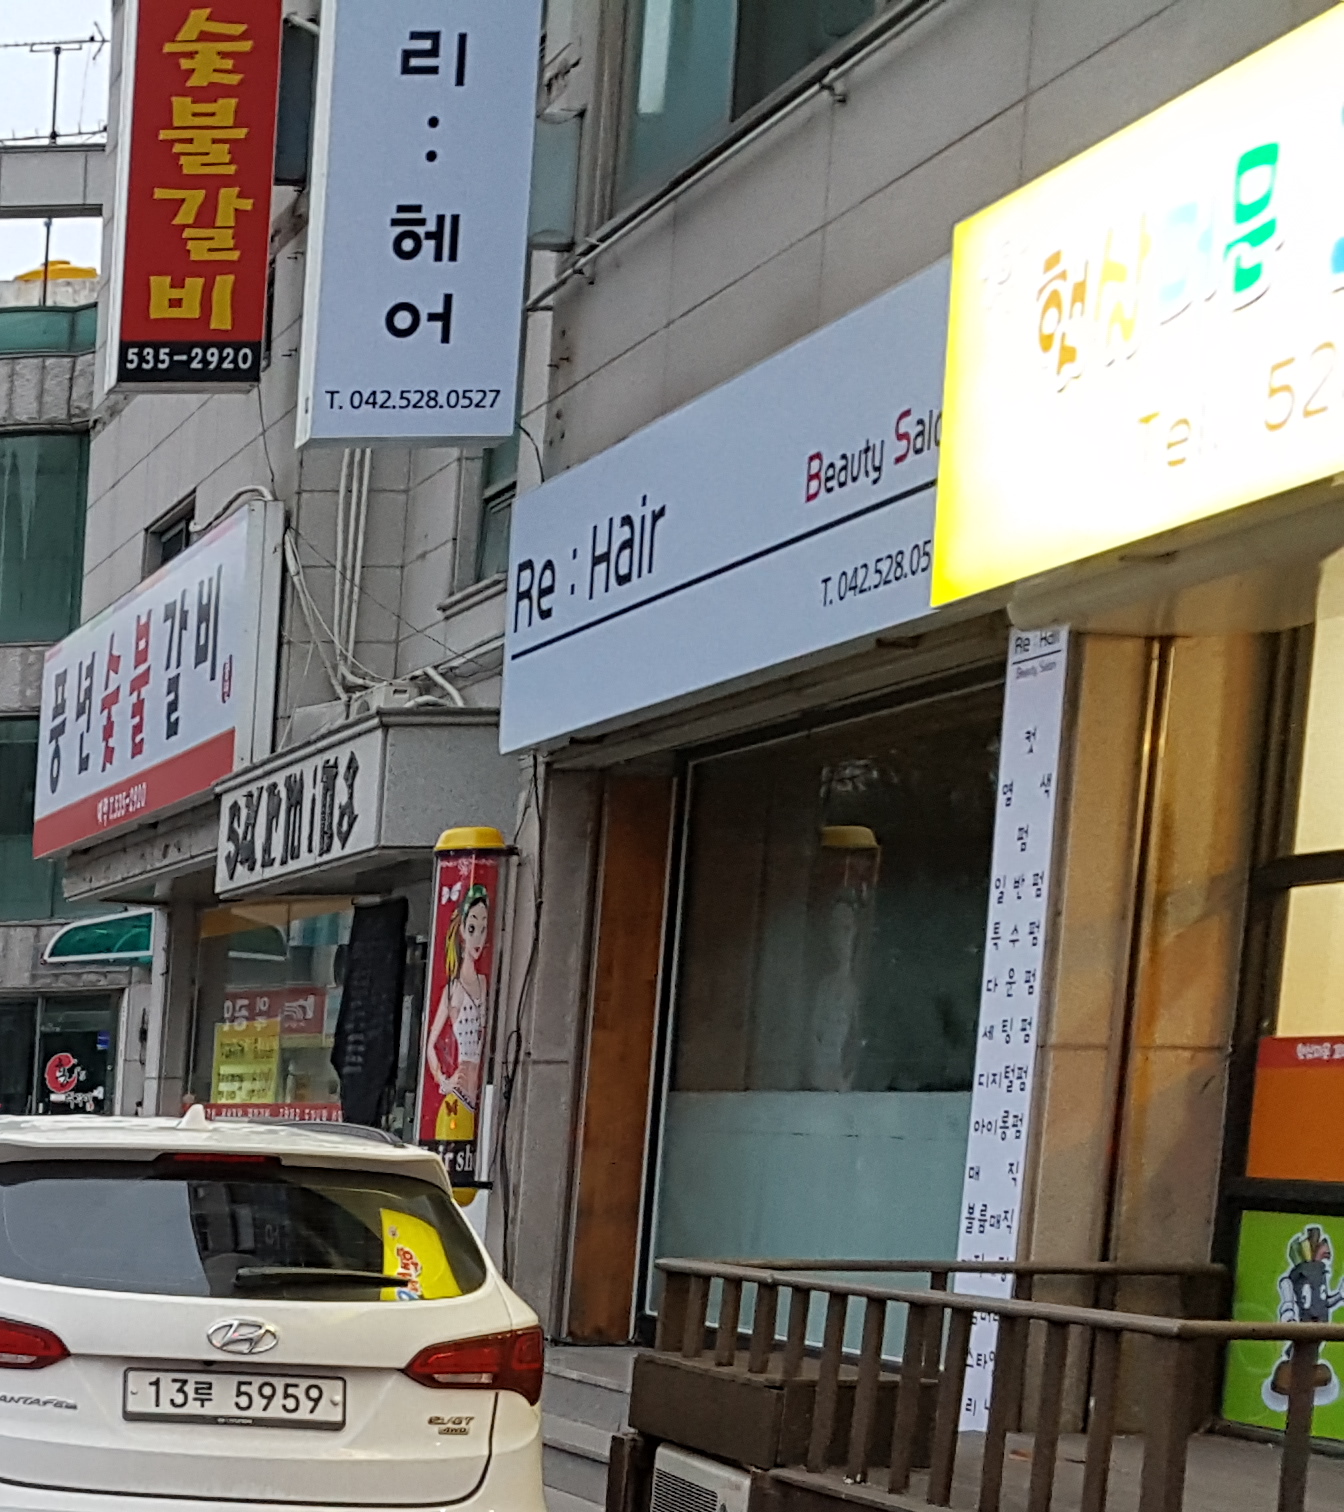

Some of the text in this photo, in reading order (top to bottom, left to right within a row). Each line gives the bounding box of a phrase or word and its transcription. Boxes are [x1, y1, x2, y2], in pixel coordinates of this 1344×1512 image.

[148, 8, 254, 331] 숯불갈비
[125, 347, 253, 371] 535-2920
[1265, 340, 1344, 433] 52
[349, 388, 501, 410] 042.528.0527
[805, 438, 885, 504] Beauty
[513, 557, 555, 633] Re
[588, 493, 667, 600] Hair
[234, 1379, 324, 1415] 5959
